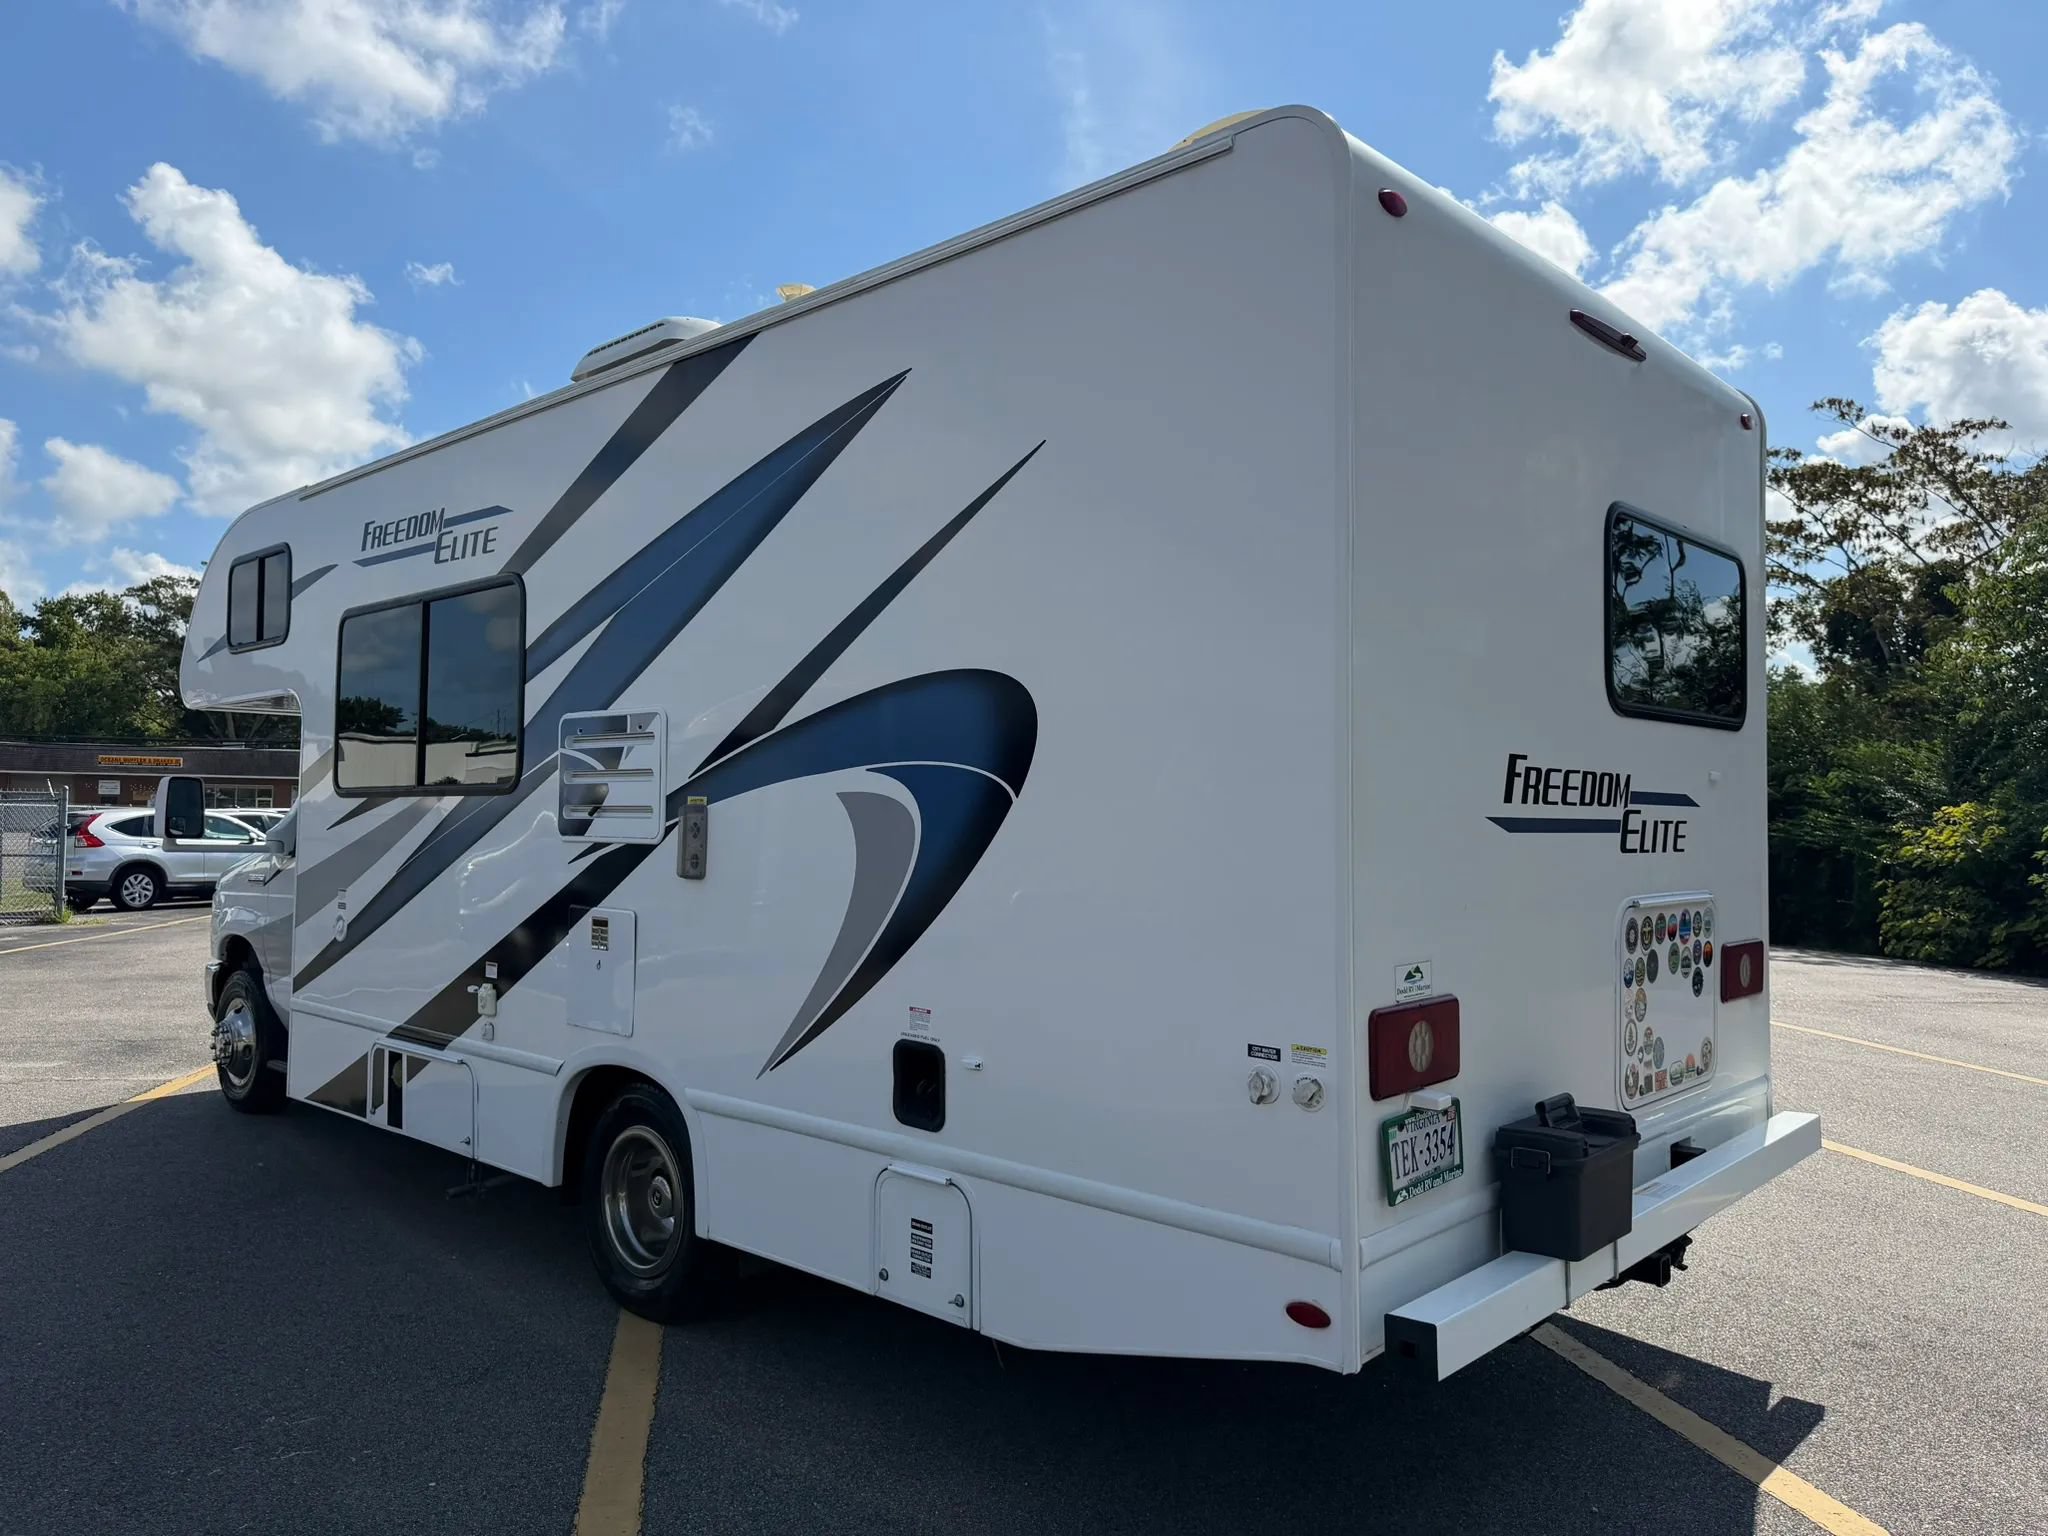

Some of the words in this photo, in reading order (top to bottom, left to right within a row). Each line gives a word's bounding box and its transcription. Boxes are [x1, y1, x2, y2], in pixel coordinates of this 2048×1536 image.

[361, 507, 446, 552] FREEDOM
[433, 526, 499, 565] ELITE
[1503, 753, 1631, 808] FREEDOM
[1619, 808, 1687, 854] ELITE
[1405, 1115, 1441, 1133] VIRGINIA
[1409, 1182, 1424, 1197] Dodd
[1424, 1177, 1433, 1189] RV
[1433, 1174, 1443, 1186] and
[1443, 1168, 1462, 1181] Marine
